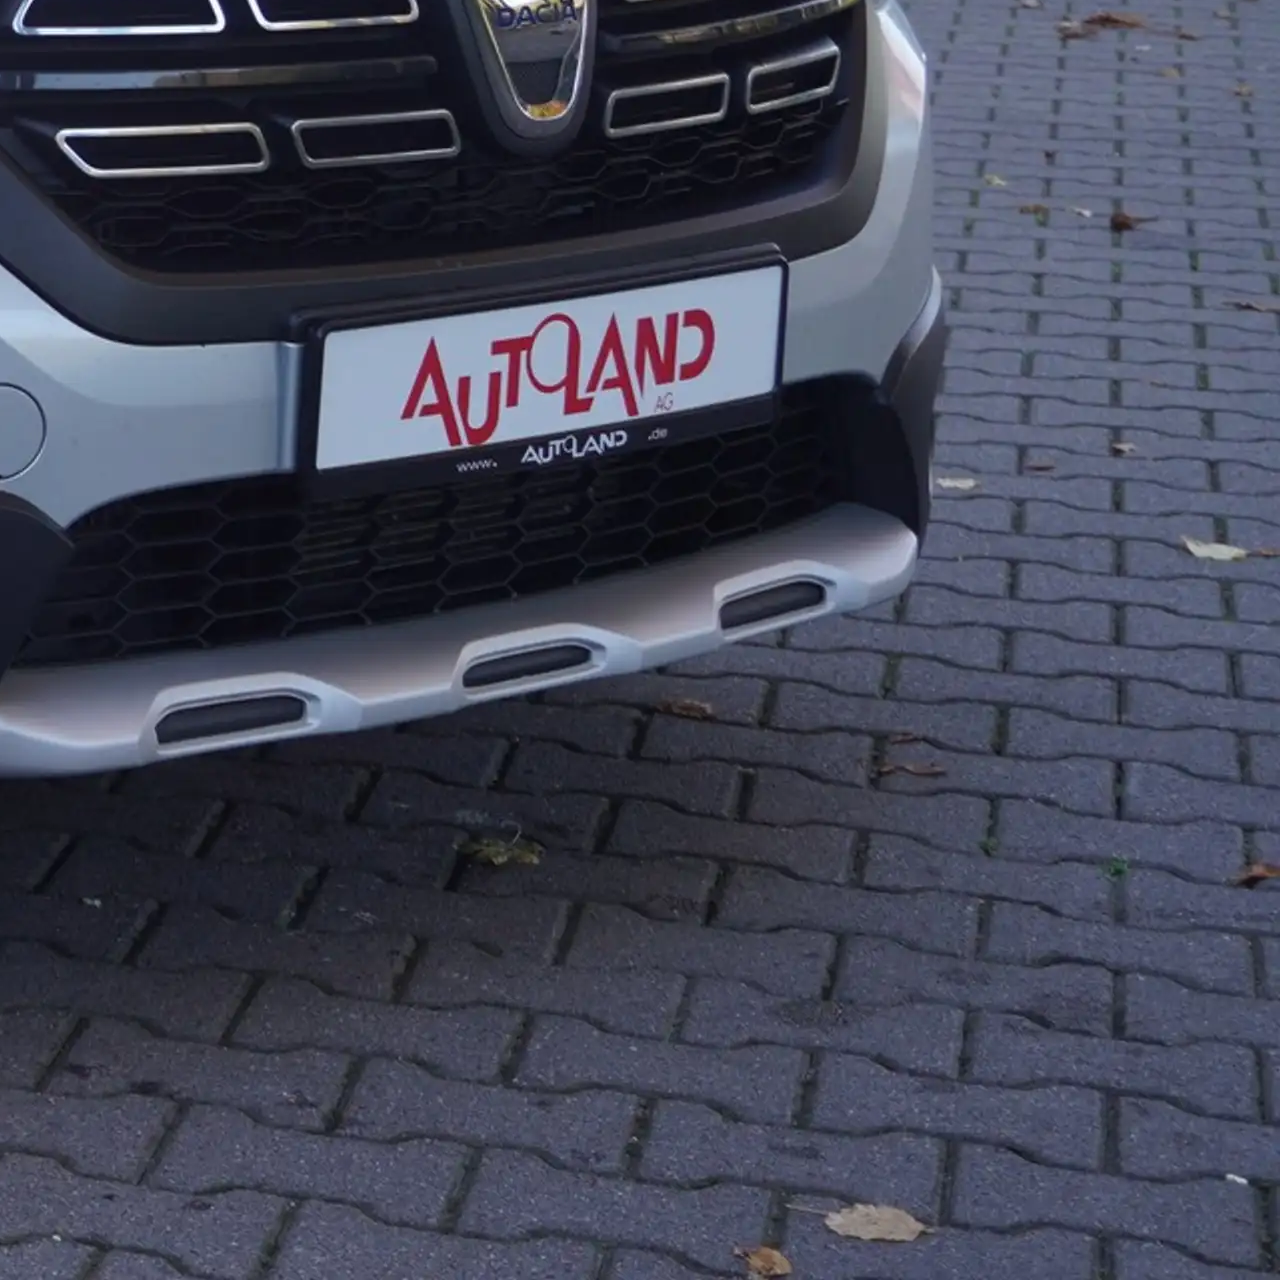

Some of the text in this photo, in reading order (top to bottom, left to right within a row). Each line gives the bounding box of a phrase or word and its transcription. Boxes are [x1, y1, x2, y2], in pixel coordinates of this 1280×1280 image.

[495, 0, 577, 29] DACIA
[400, 307, 716, 447] AUTOLAND
[654, 392, 675, 413] AG
